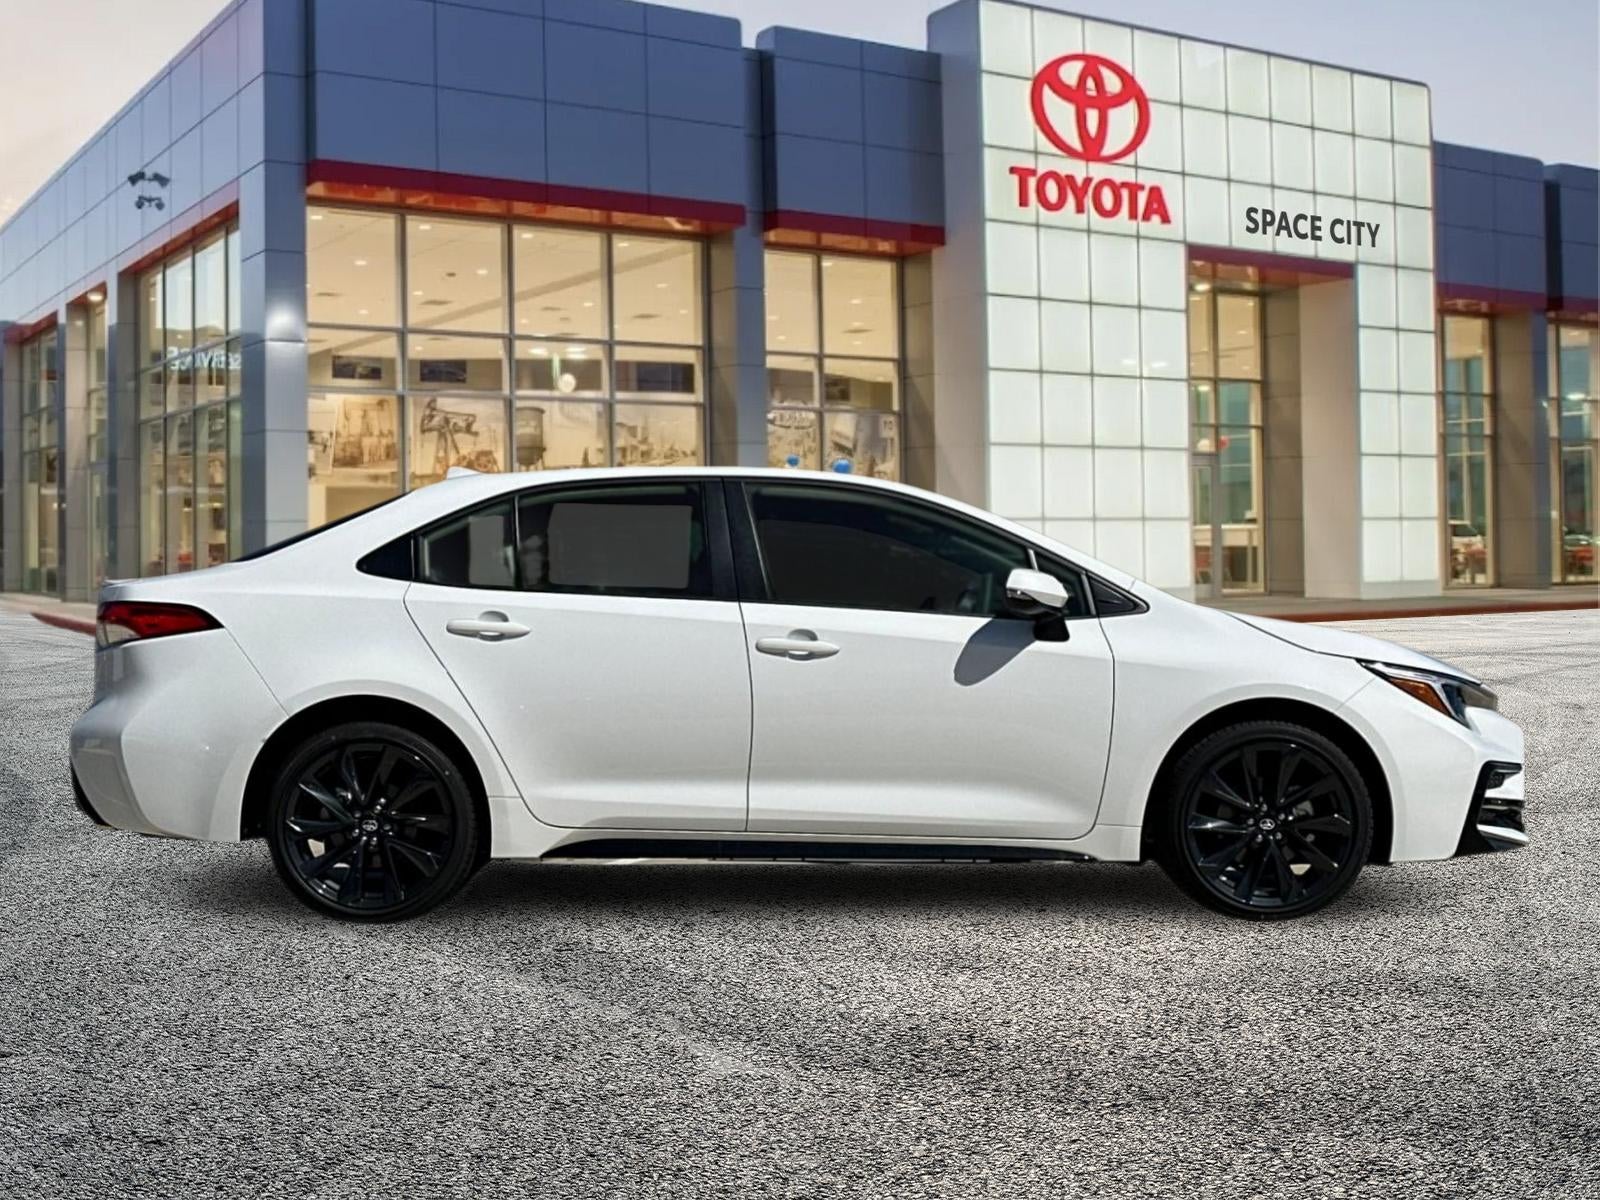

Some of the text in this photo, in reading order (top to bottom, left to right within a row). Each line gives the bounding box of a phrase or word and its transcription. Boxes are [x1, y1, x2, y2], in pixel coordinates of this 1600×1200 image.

[1009, 166, 1171, 225] TOYOTA
[1245, 207, 1381, 248] SPACE CITY
